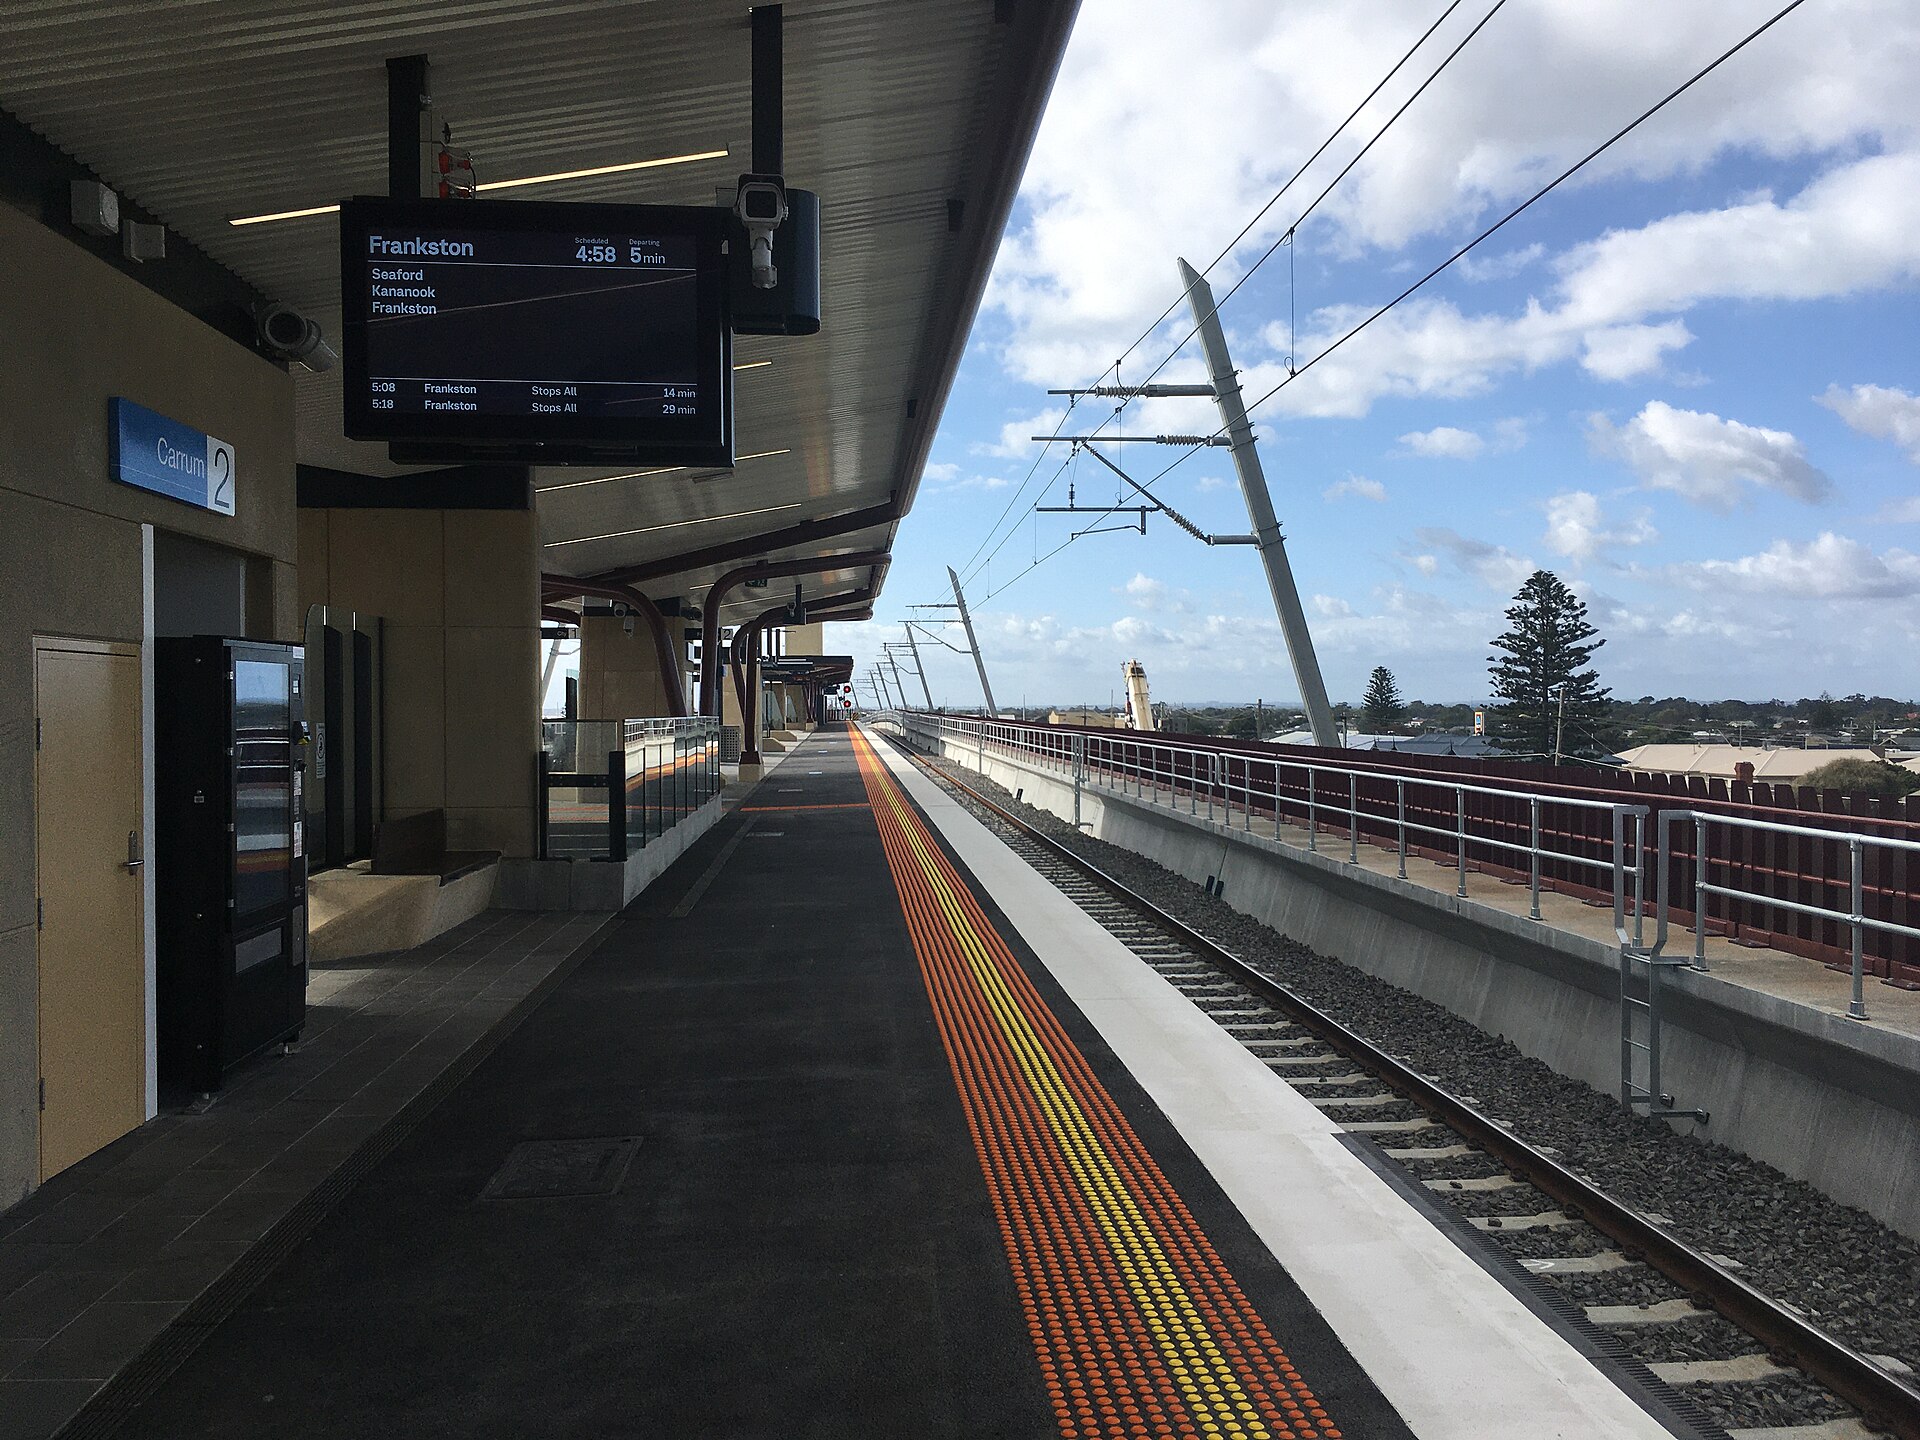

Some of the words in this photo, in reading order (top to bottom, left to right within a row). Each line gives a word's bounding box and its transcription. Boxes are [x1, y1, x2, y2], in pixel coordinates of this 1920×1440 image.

[369, 235, 474, 256] Frankston
[628, 238, 660, 247] Departing
[575, 245, 617, 262] 4:58
[630, 247, 642, 263] 5
[643, 253, 666, 264] min
[372, 268, 423, 280] Seaford
[372, 285, 436, 298] Kananook
[372, 301, 437, 315] Frankston
[371, 382, 396, 392] 5:08
[424, 383, 477, 394] Frankston
[531, 386, 561, 397] Stops
[563, 386, 578, 396] All
[663, 388, 676, 398] 14
[677, 388, 696, 398] min
[372, 399, 394, 409] 5:18
[424, 400, 477, 411] Frankston
[531, 403, 561, 414] Stops
[563, 403, 578, 413] All
[662, 405, 676, 414] 29
[677, 405, 696, 415] min
[157, 437, 205, 479] Carrum
[214, 447, 230, 509] 2
[723, 629, 732, 640] 2
